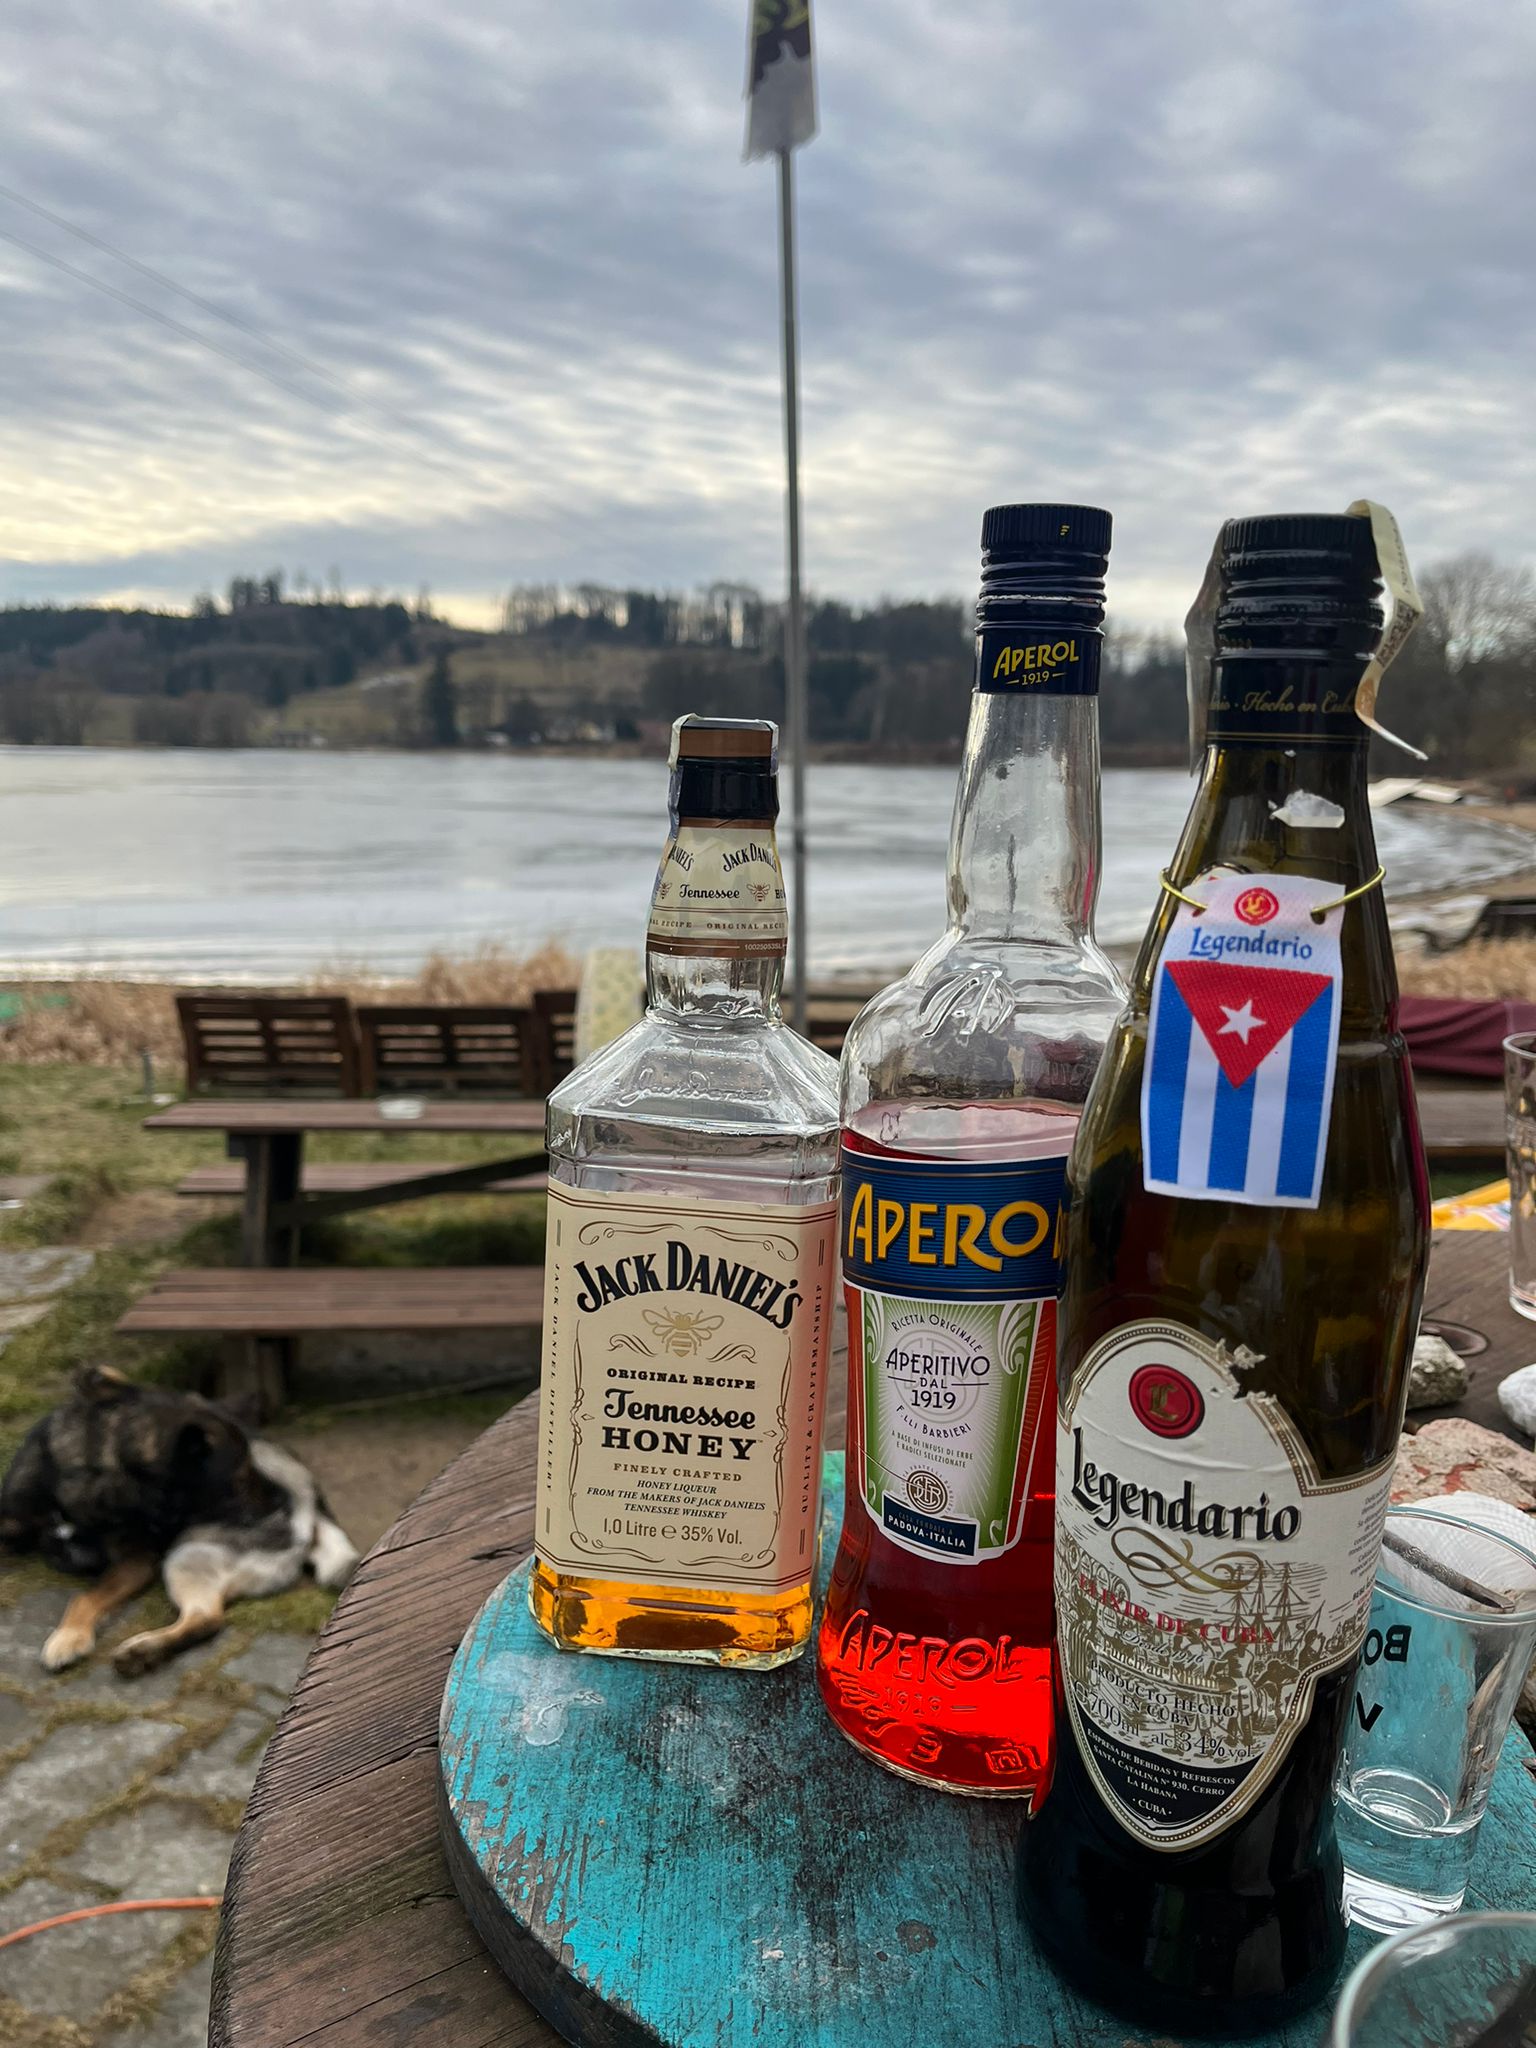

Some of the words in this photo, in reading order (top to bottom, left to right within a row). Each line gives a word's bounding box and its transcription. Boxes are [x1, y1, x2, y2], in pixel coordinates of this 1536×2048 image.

[993, 640, 1079, 679] APEROL
[1021, 670, 1050, 686] 1919
[1321, 690, 1355, 714] Cub
[722, 847, 750, 872] JACK
[679, 884, 740, 899] Tennessee
[1188, 927, 1312, 960] Legendario
[573, 1254, 663, 1313] JACK
[665, 1241, 803, 1329] DANIEL'S
[891, 1314, 925, 1332] RICETTA
[929, 1314, 983, 1352] ORIGINALE
[885, 1347, 990, 1377] APERITIVO
[606, 1368, 688, 1384] ORIGINAL
[693, 1375, 756, 1390] RECIPE
[920, 1377, 948, 1389] DAL
[603, 1388, 756, 1430] Tennessee
[802, 1443, 812, 1513] QUALITY
[807, 1284, 821, 1423] CRAFTSMANSHIP
[911, 1389, 956, 1410] 1919
[601, 1426, 757, 1460] HONEY
[922, 1423, 972, 1439] BARBIERI
[613, 1463, 668, 1476] FINELY
[673, 1468, 742, 1482] CRAFTED
[637, 1480, 672, 1490] HONEY
[673, 1483, 717, 1495] LIQUEUR
[1071, 1427, 1301, 1542] Legendario
[586, 1487, 615, 1497] FROM
[617, 1490, 638, 1500] THE
[639, 1493, 681, 1504] MAKERS
[683, 1497, 698, 1505] OF
[697, 1498, 722, 1508] JACK
[624, 1503, 679, 1516] TENNESSEE
[682, 1508, 728, 1520] WHISKEY
[626, 1520, 657, 1538] Litre
[681, 1526, 714, 1543] 35%
[717, 1528, 743, 1545] Vol.
[1079, 1574, 1150, 1626] ELIXIR
[1156, 1611, 1189, 1635] DE
[1199, 1624, 1277, 1645] CUBA
[839, 1609, 1023, 1689] APEROL
[1090, 1660, 1168, 1705] PRODUCTO
[1174, 1697, 1235, 1717] HECHO
[1089, 1693, 1140, 1737] 700ml
[1179, 1730, 1226, 1757] 34%
[1122, 1694, 1142, 1711] EN
[1146, 1704, 1191, 1726] CUBA
[1087, 1728, 1120, 1755] EMPRESA
[1120, 1750, 1132, 1761] DE
[1133, 1754, 1171, 1775] BEBIDAS
[1173, 1770, 1180, 1778] Y
[1181, 1770, 1236, 1785] REFRESCOS
[1093, 1744, 1117, 1765] SANTA
[1117, 1760, 1159, 1784] CATALINA
[1192, 1785, 1225, 1796] CERRO
[1127, 1775, 1139, 1788] LA
[1140, 1782, 1178, 1800] HABANA
[1138, 1798, 1167, 1816] CUBA
